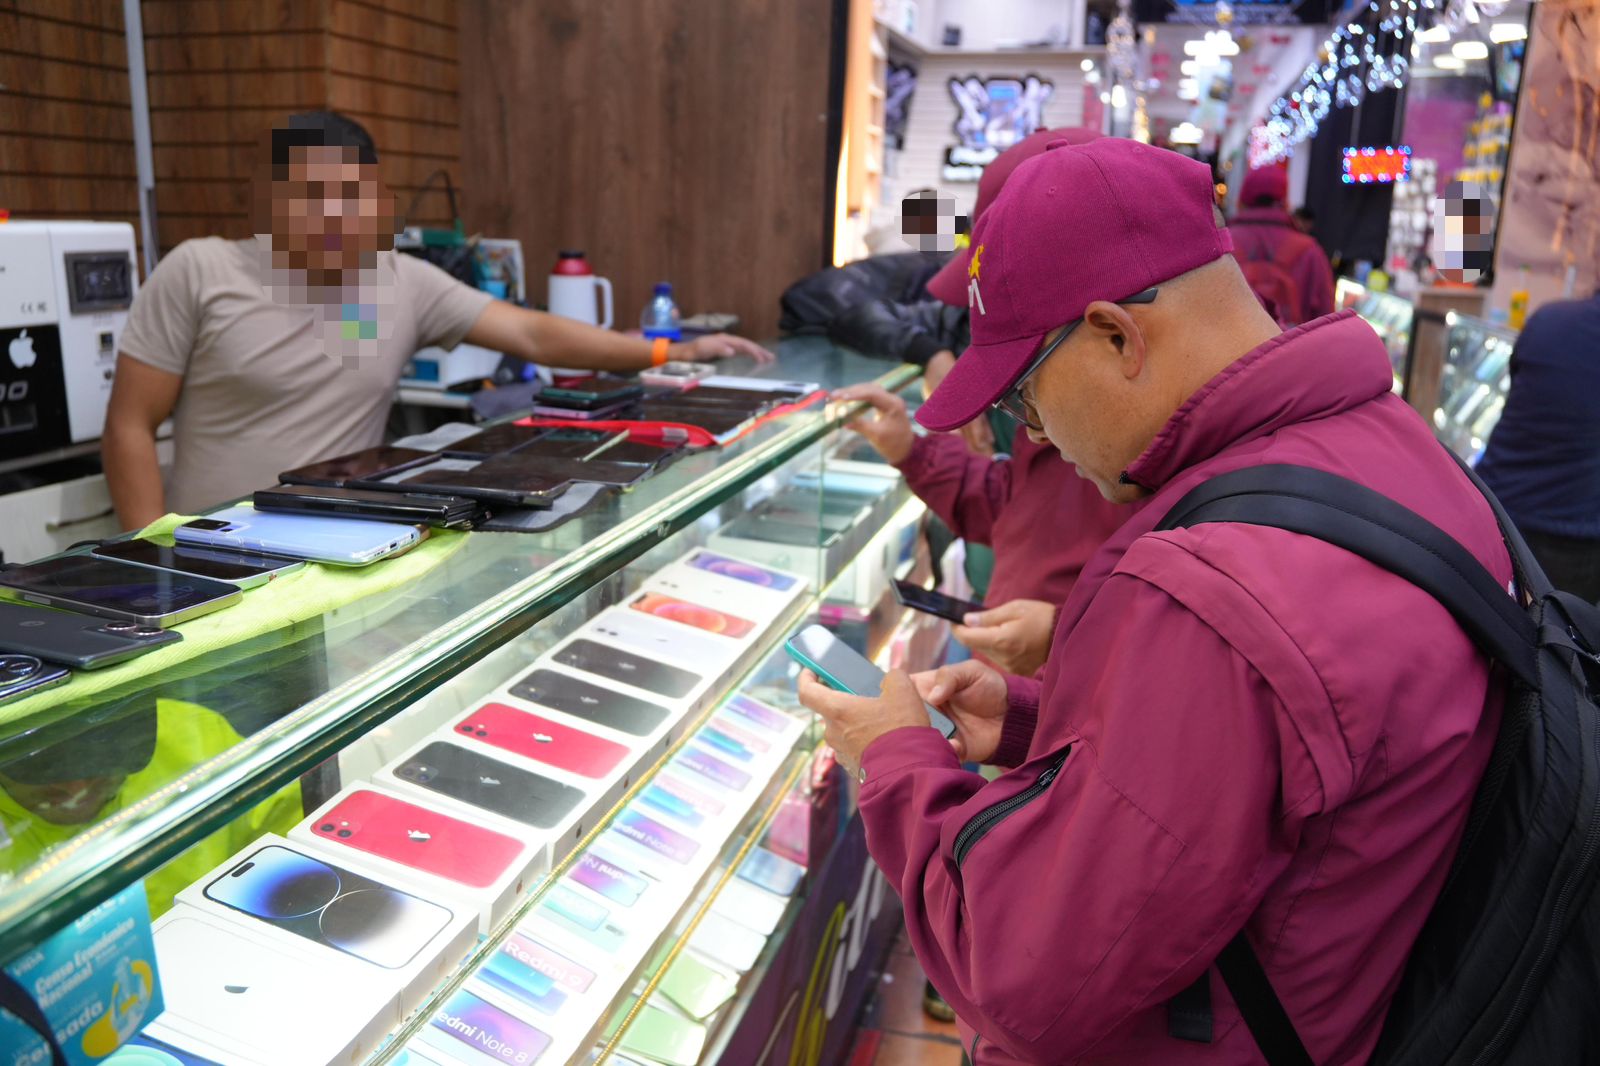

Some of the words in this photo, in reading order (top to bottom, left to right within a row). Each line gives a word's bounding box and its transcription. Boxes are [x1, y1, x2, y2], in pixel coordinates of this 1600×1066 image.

[505, 941, 567, 980] Redmi
[437, 1010, 478, 1038] edmi
[476, 1030, 514, 1058] Note
[514, 1051, 529, 1064] 8
